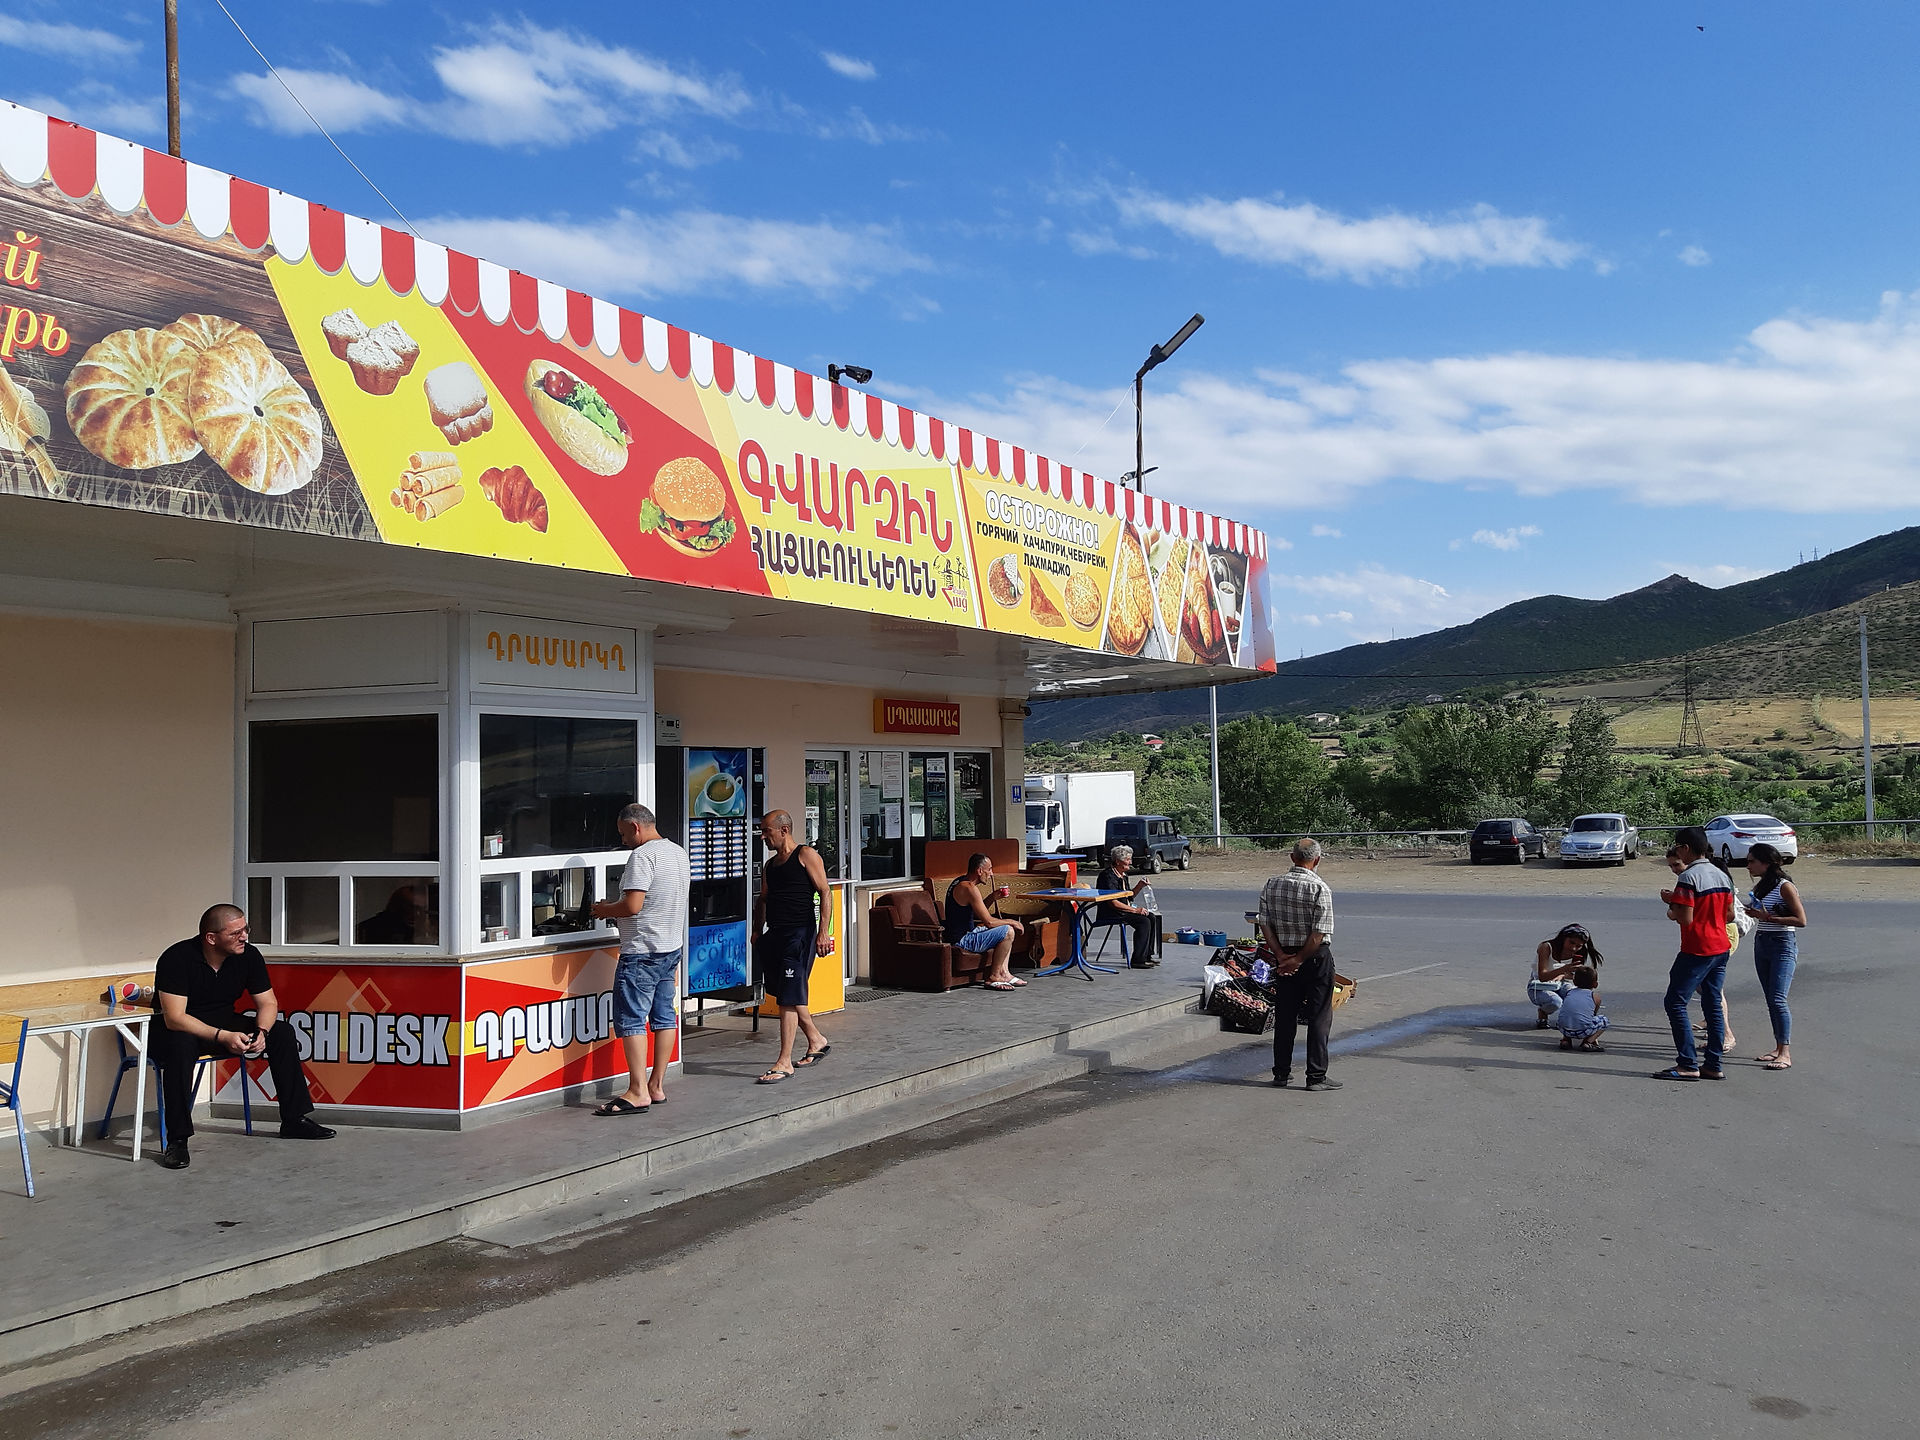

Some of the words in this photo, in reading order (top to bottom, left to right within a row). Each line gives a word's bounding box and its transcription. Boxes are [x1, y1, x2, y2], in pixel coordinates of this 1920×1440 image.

[0, 230, 42, 290] й
[738, 439, 953, 553] ԳՎԱՐԶԻՆ
[986, 490, 1099, 550] ОСТОРОЖНО!
[976, 521, 1019, 544] ГОРЯЧИЙ
[751, 525, 937, 599] ՀԱՑԱԲՈՒԼԿԵՂԵՆ
[1024, 552, 1071, 577] ЛАХМАДЖО
[487, 631, 626, 672] ԴՐԱՄԱՐԿՂ
[887, 706, 959, 728] ՍՊԱՍԱՍՐԱՀ
[242, 1011, 340, 1062] SH
[349, 1013, 450, 1066] DESK
[475, 990, 614, 1062] ԴՐԱՄԱՐ
